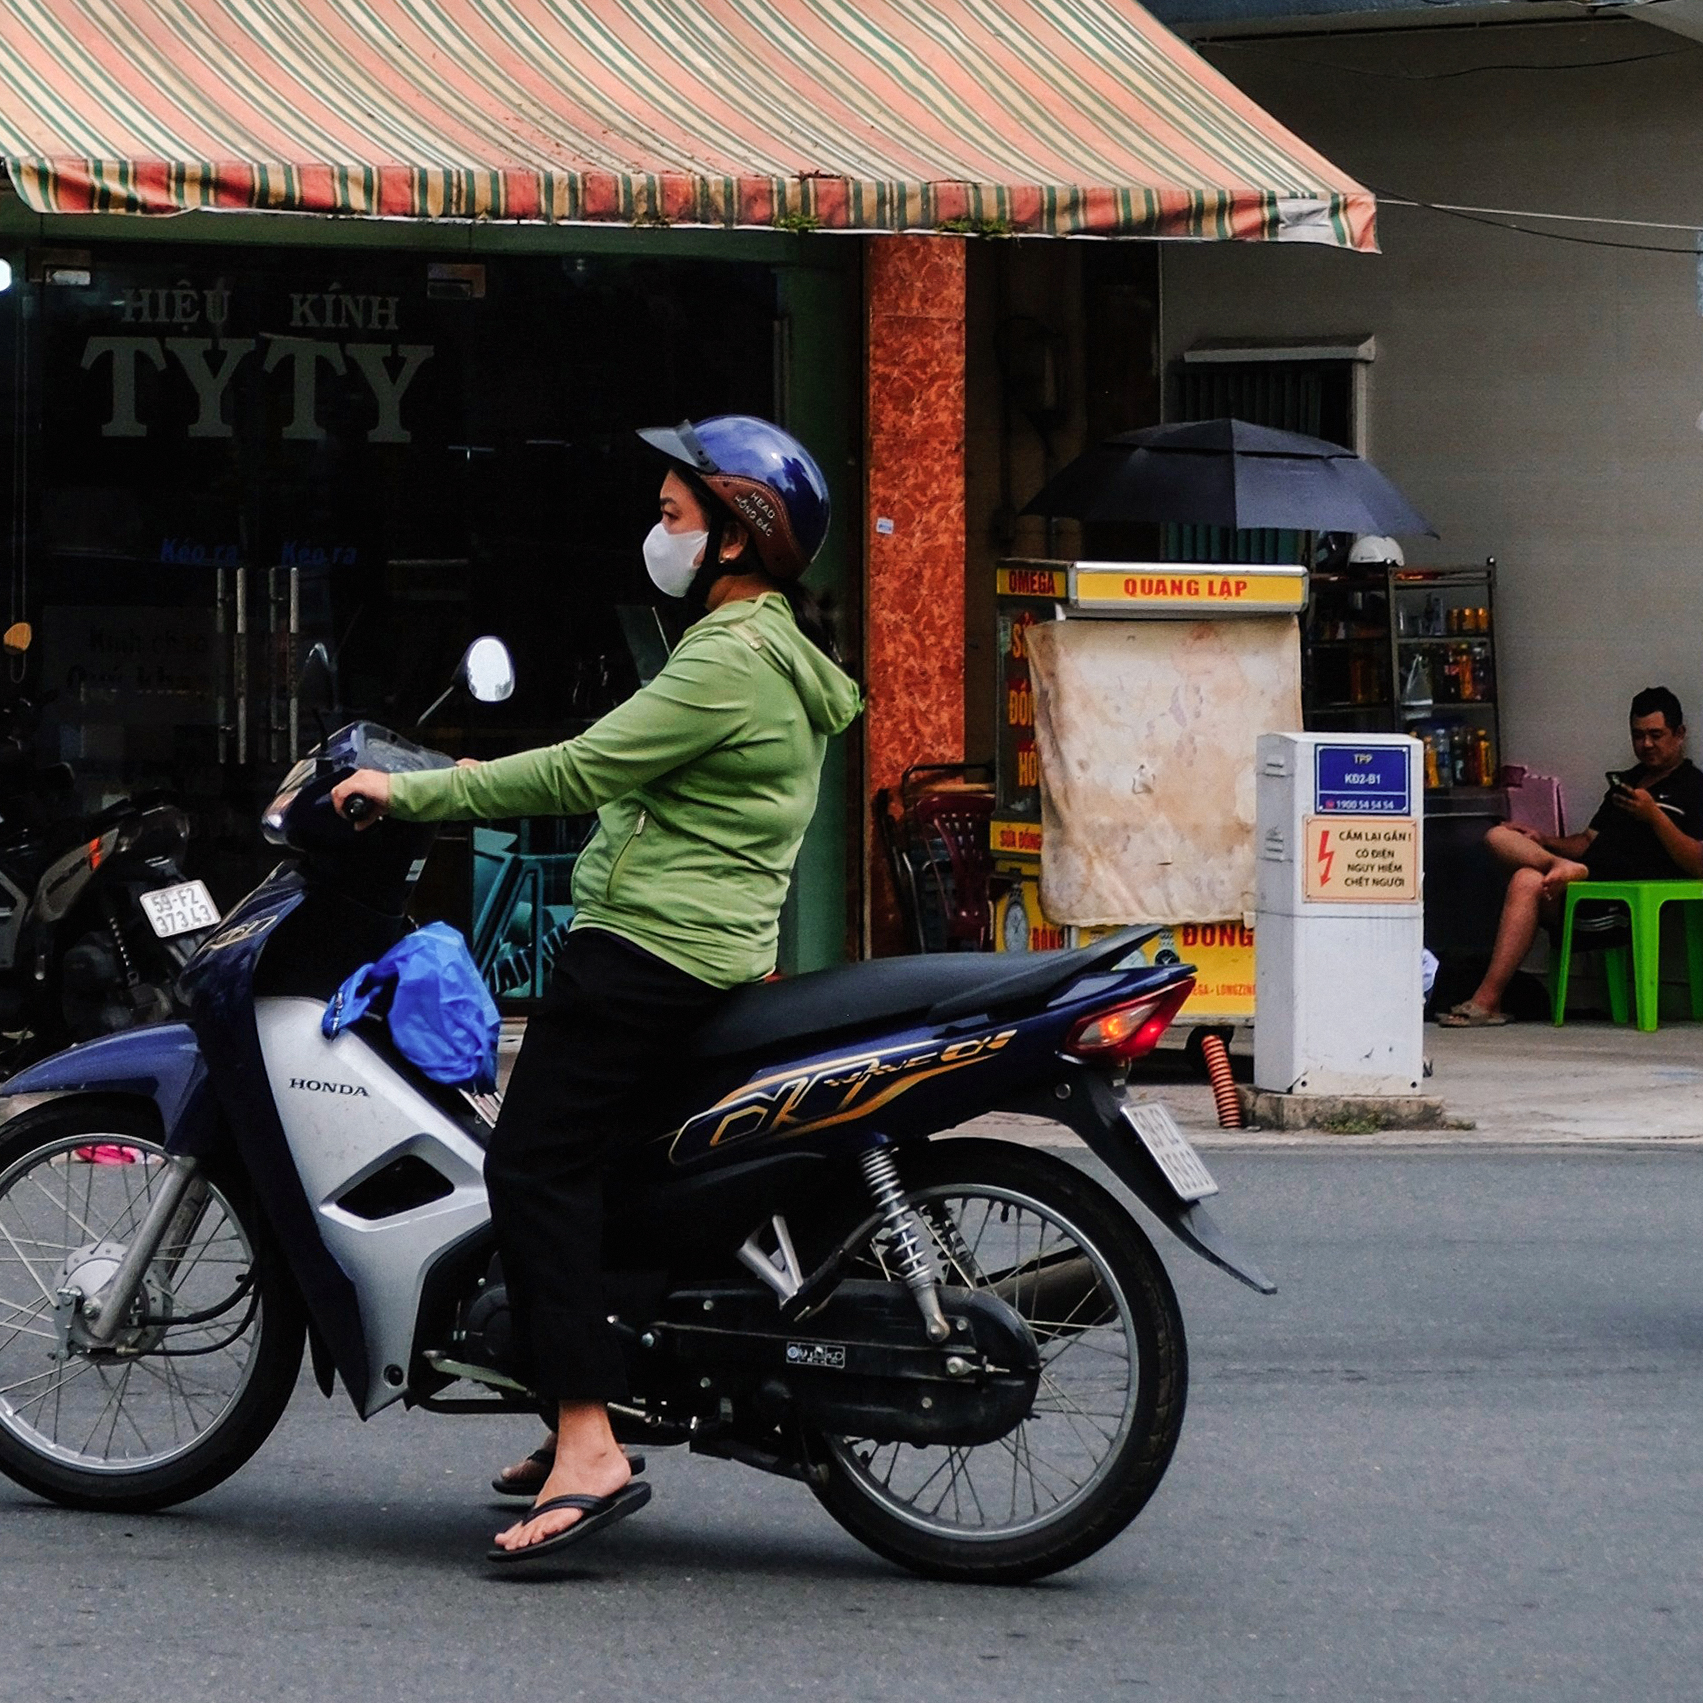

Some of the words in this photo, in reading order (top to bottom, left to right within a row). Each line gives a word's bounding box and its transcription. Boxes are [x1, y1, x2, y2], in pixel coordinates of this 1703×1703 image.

[122, 279, 231, 332] HIỆU
[289, 282, 400, 332] KÍNH
[1008, 570, 1055, 594] OMEGA
[1123, 577, 1200, 598] QUANG
[1207, 576, 1249, 601] LẬP
[151, 887, 200, 915] 59-F2
[289, 1077, 370, 1097] HONDA
